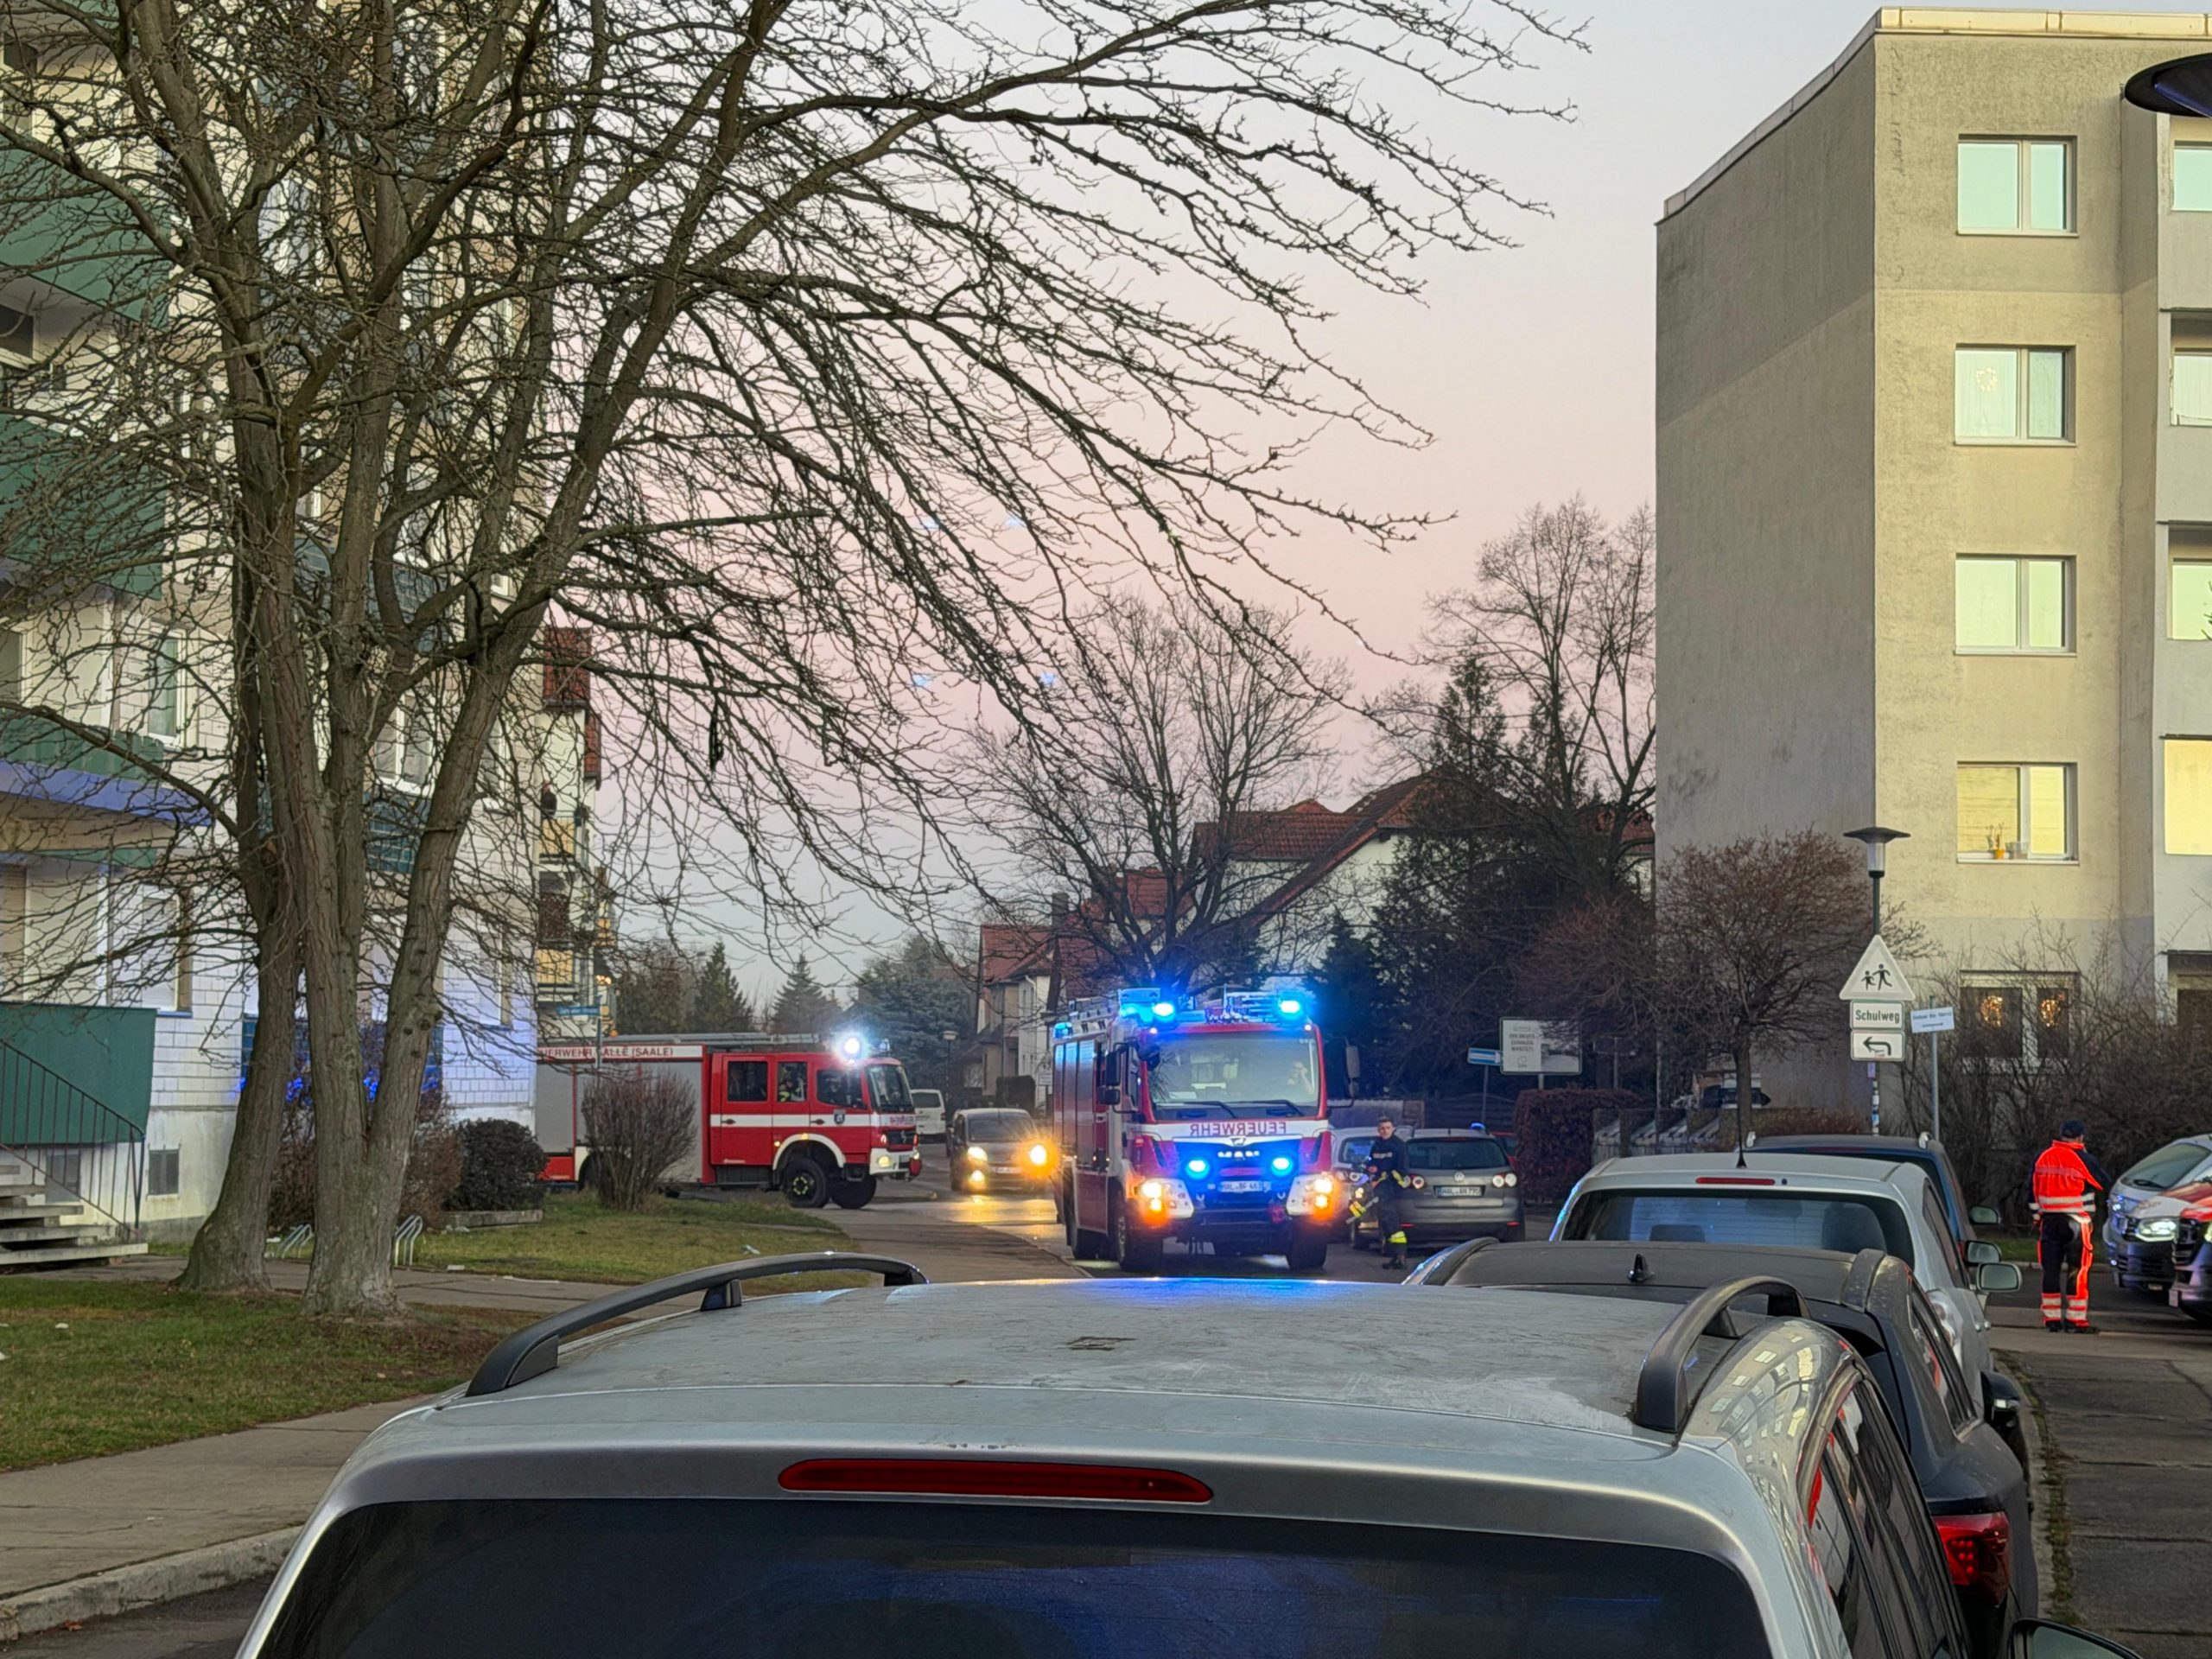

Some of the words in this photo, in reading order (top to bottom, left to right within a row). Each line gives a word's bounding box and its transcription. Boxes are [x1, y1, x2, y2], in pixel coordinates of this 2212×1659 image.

[1855, 1009, 1900, 1024] Schulweg
[601, 1046, 630, 1057] ALLE
[632, 1046, 674, 1058] (SAALE)
